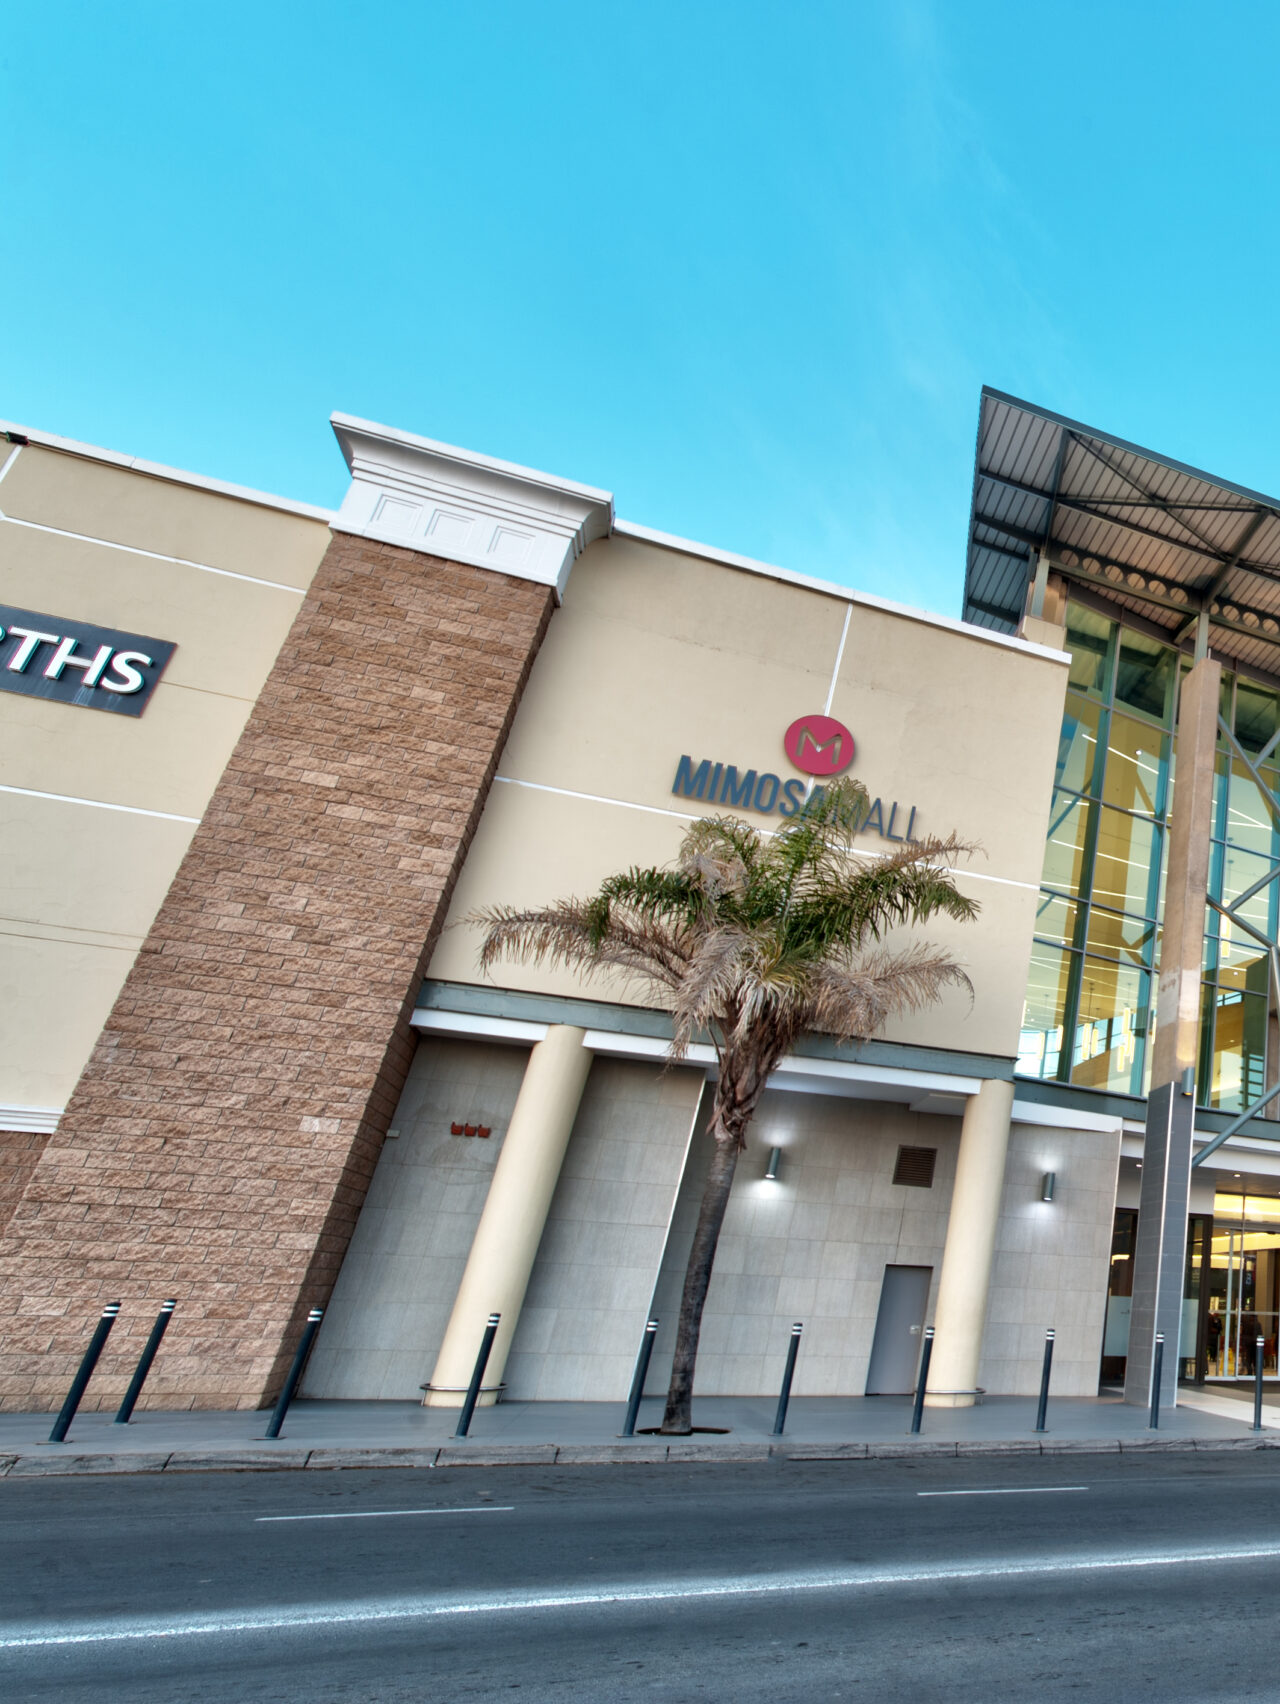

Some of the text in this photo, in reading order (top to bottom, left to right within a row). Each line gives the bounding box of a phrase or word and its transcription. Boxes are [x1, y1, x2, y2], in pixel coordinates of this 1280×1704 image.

[0, 624, 153, 695] THS
[795, 725, 842, 765] M
[672, 754, 826, 822] MIMOSA
